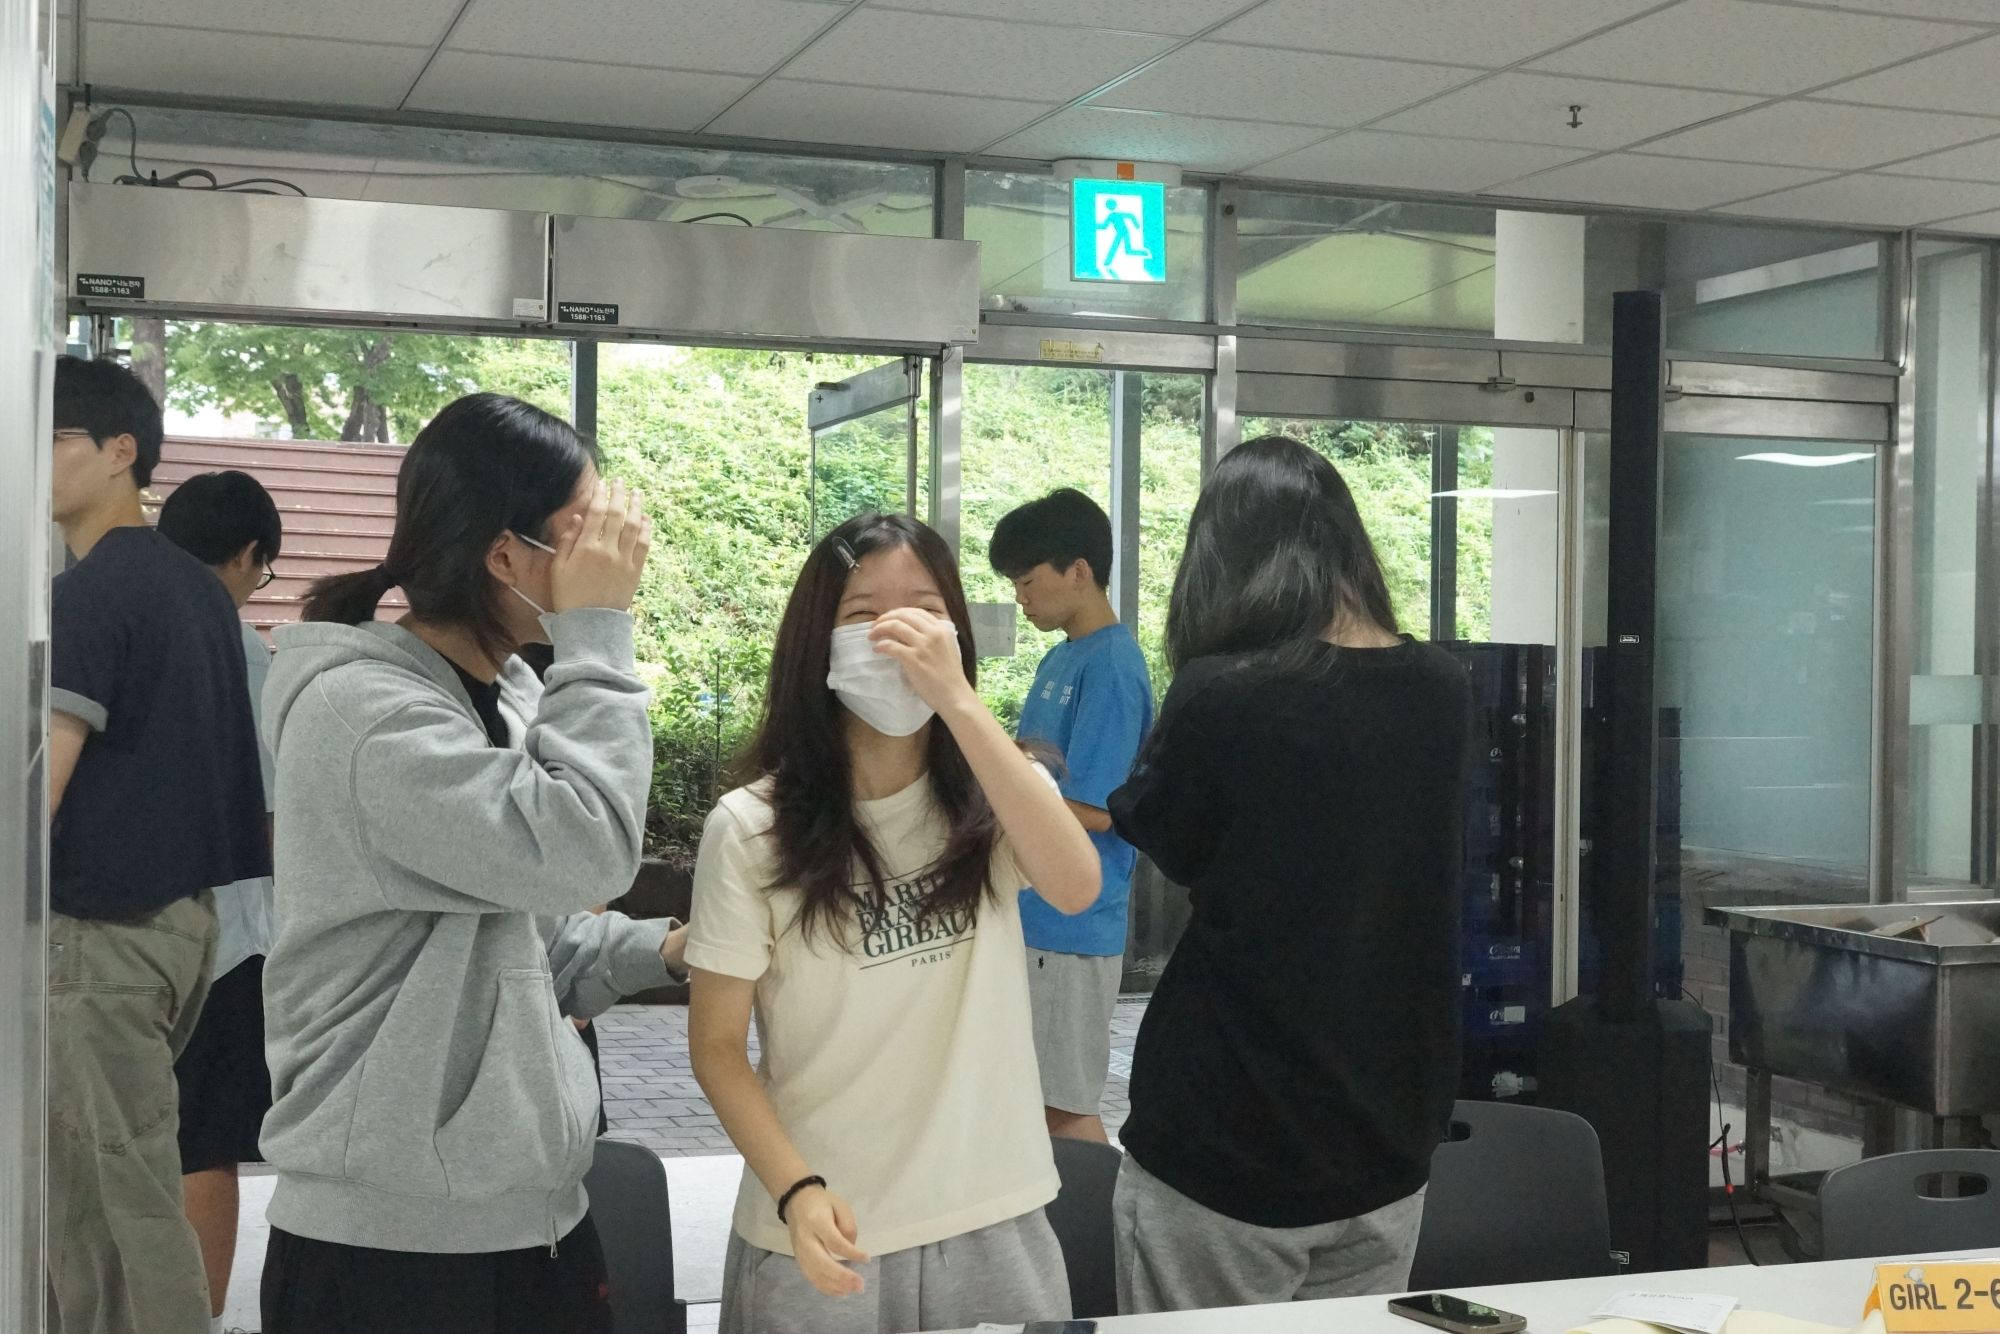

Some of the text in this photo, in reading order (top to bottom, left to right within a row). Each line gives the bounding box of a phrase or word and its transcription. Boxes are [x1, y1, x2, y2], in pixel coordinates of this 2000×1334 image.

[89, 278, 112, 286] NANO
[571, 313, 606, 321] 1588-1163
[911, 950, 952, 967] PARIS
[1889, 1283, 1947, 1310] GIRL
